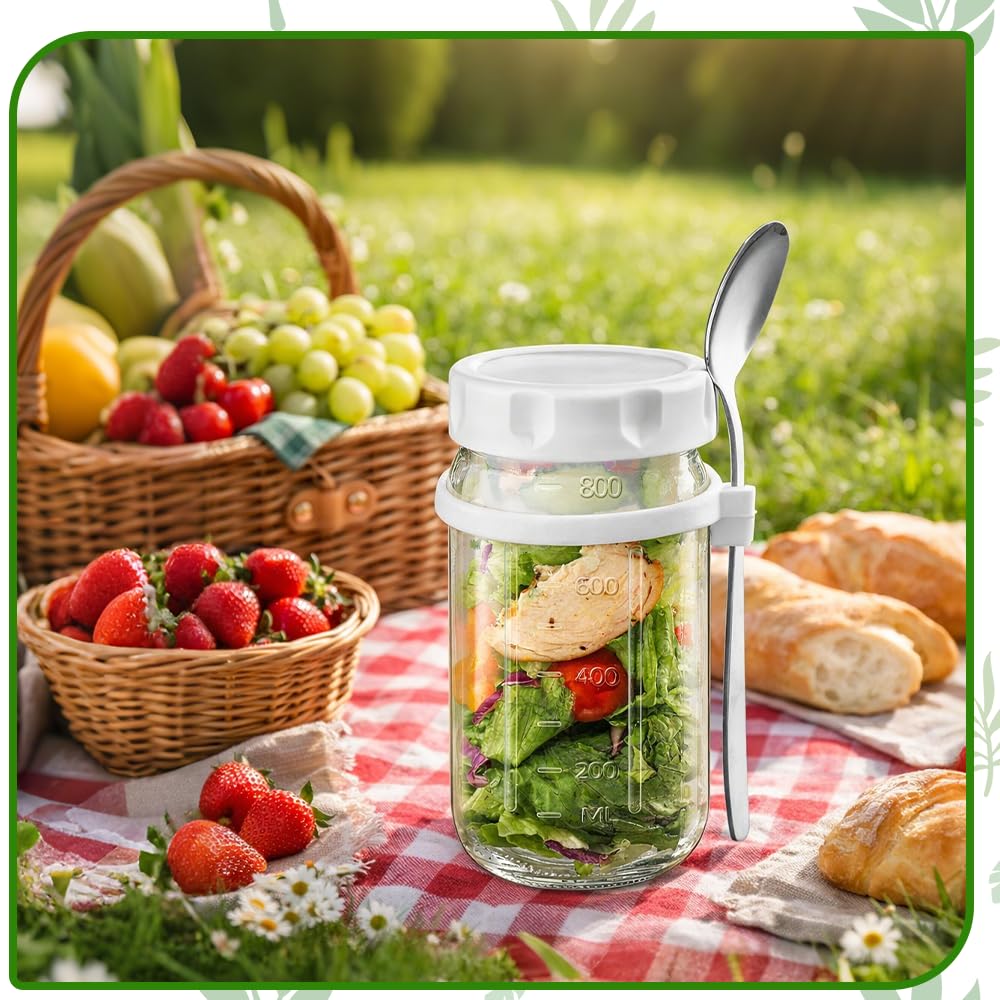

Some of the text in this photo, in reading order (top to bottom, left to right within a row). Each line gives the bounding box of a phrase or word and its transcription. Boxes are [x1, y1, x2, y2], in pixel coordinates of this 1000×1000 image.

[579, 475, 623, 499] 800
[575, 576, 620, 596] 600
[575, 665, 620, 687] 400
[574, 761, 620, 780] 200
